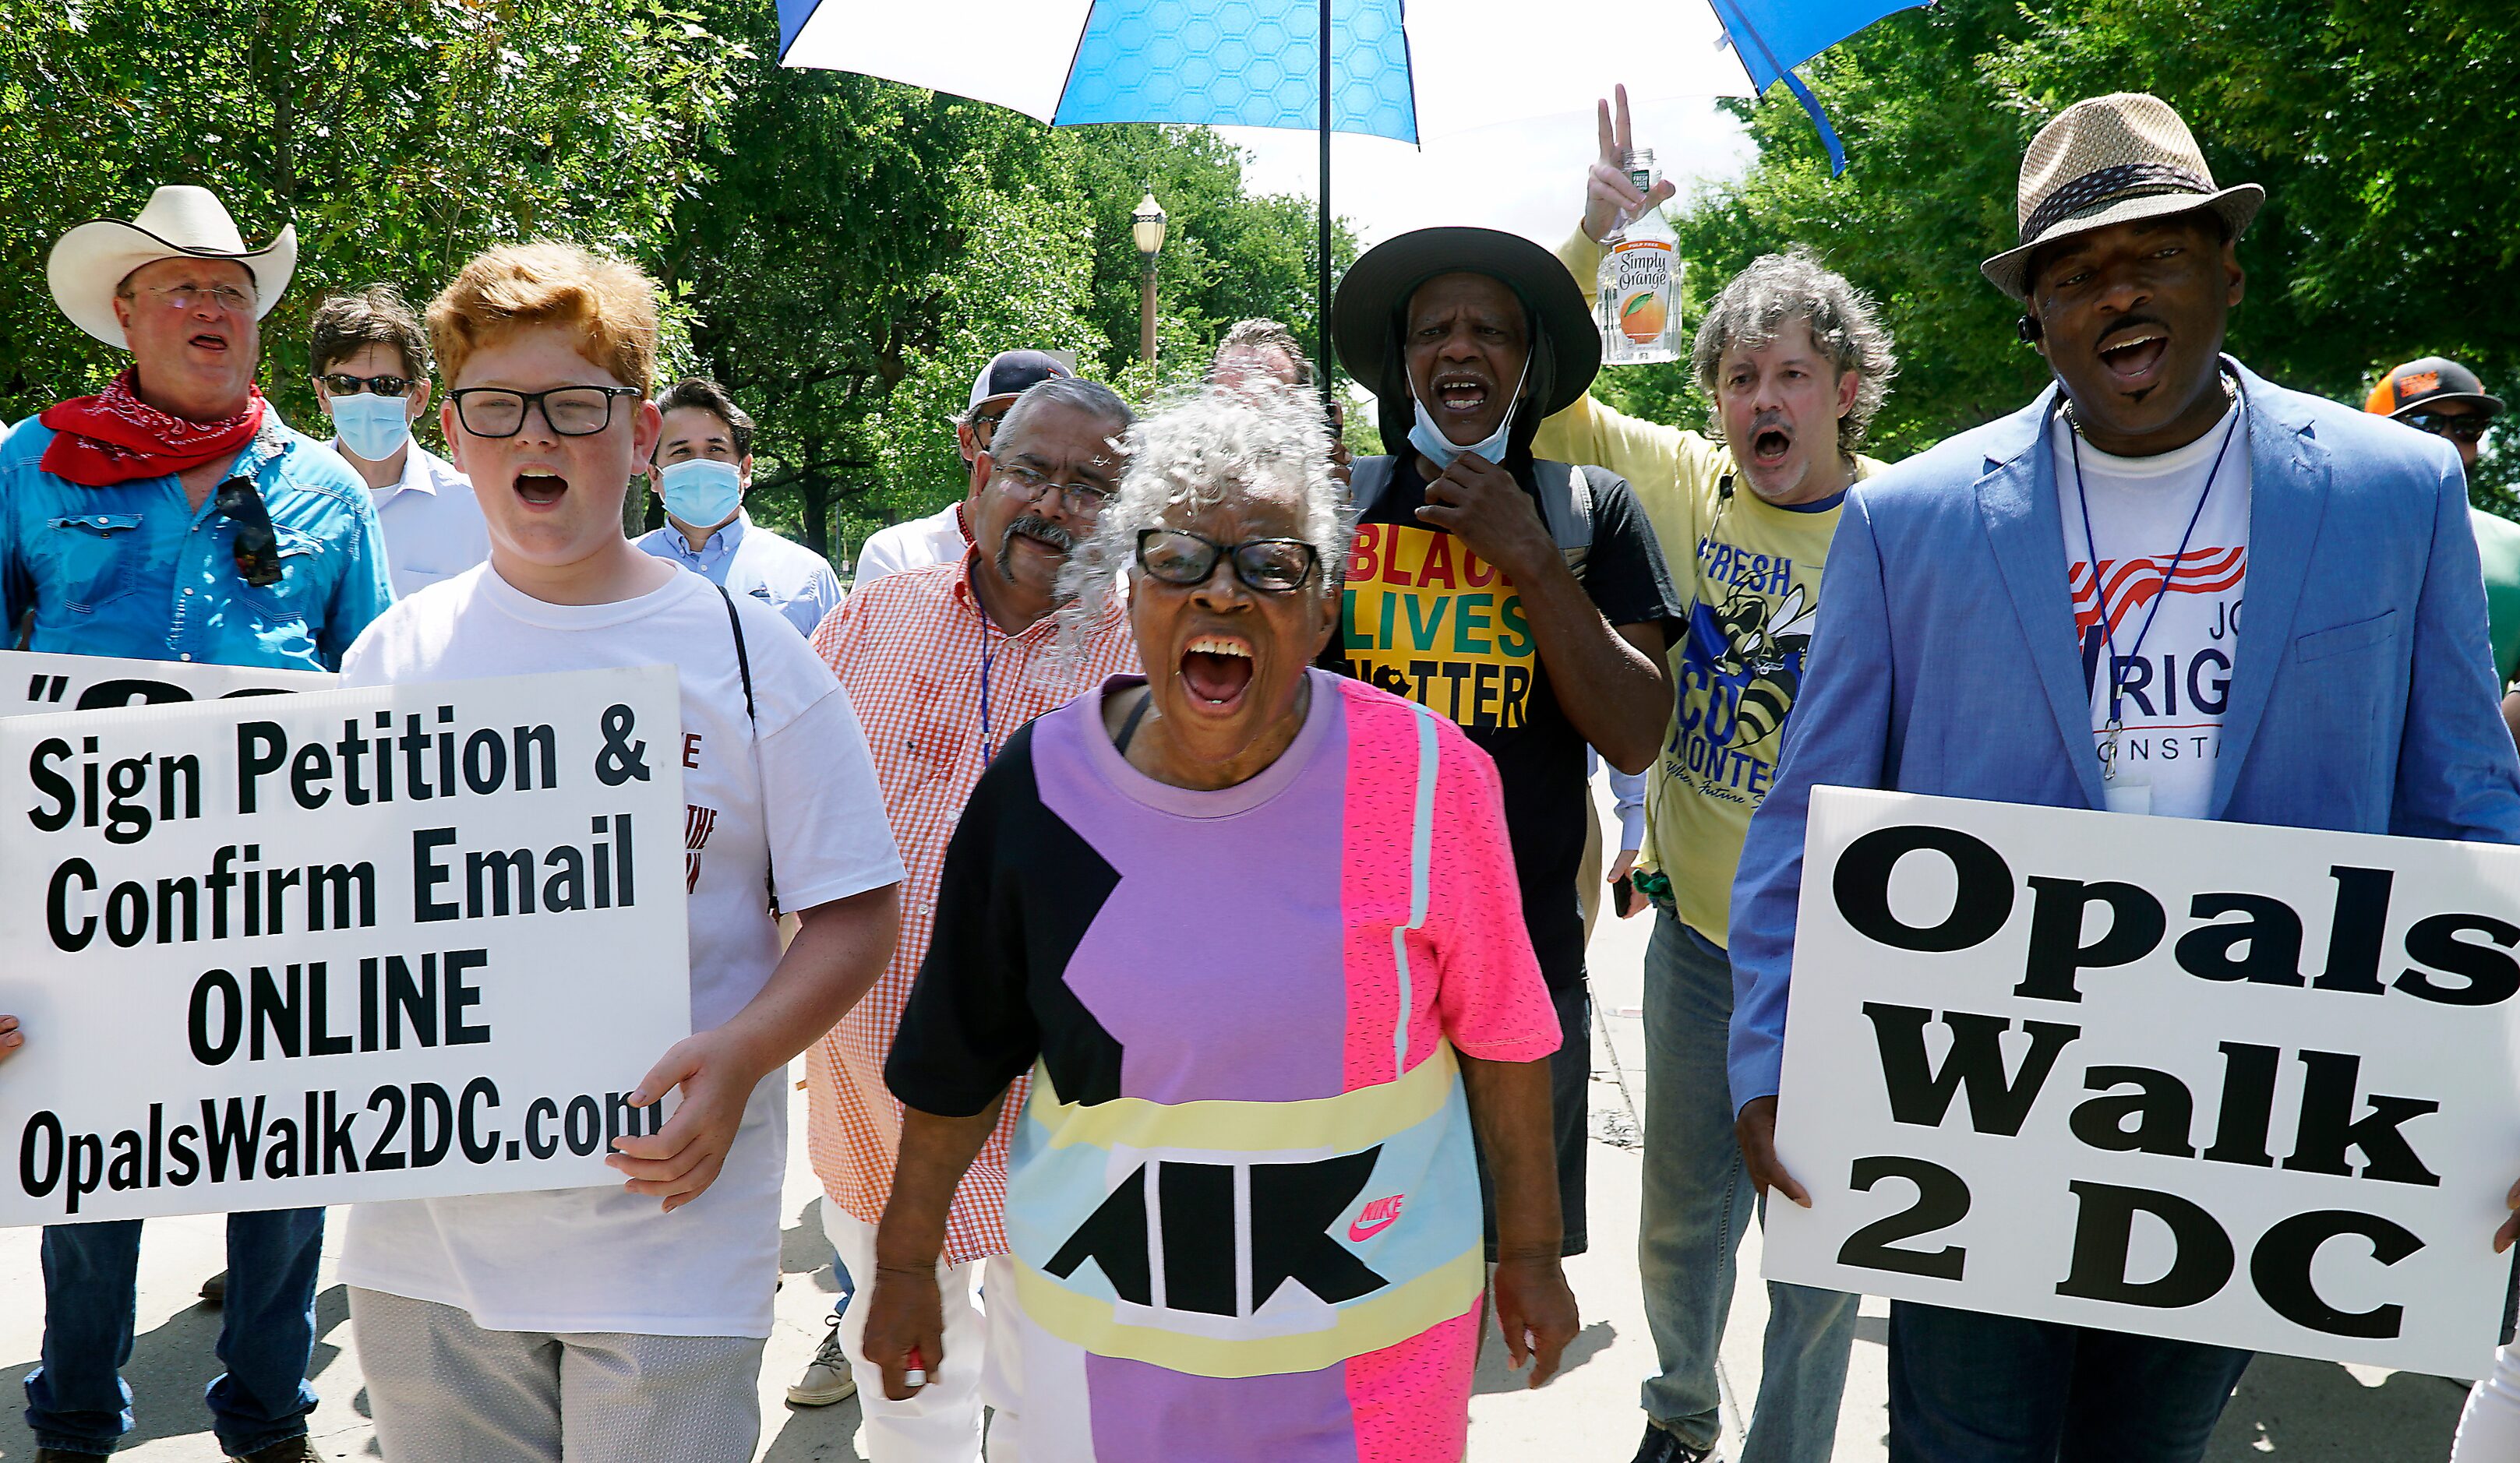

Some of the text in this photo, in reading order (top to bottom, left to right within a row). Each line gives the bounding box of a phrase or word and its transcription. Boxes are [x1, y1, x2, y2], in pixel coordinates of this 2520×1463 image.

[1619, 271, 1667, 291] Orange
[1620, 252, 1666, 273] Simply
[1346, 524, 1513, 590] BLAC
[1697, 537, 1792, 597] FRESH
[1342, 590, 1536, 658] LIVES
[26, 703, 651, 844] Sign Petition &
[1668, 728, 1778, 795] MONTE
[1699, 780, 1745, 803] Future
[686, 804, 718, 849] THE
[45, 813, 636, 954] Confirm Email
[1832, 824, 2520, 1007] Opals
[188, 948, 492, 1068] ONLINE
[1862, 1001, 2441, 1188] Walk
[19, 1076, 662, 1215] OpalsWalk2DC.com
[1042, 1143, 1391, 1318] AIR
[1358, 1194, 1405, 1222] NIKE
[1836, 1155, 2426, 1340] 2 DC
